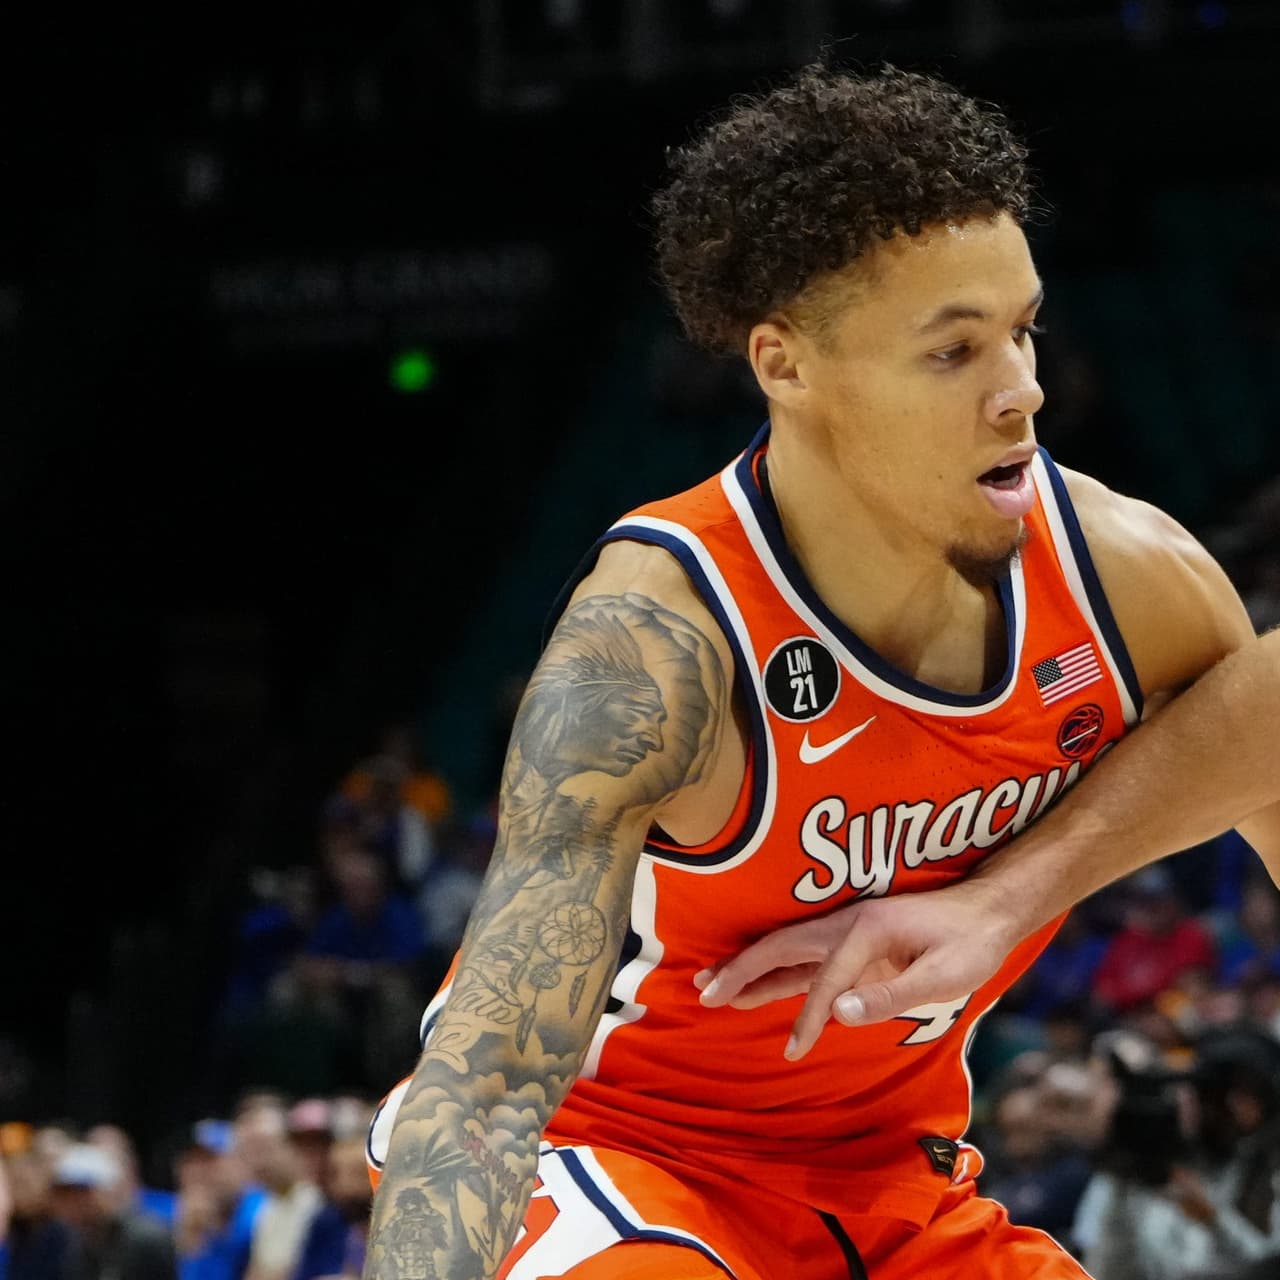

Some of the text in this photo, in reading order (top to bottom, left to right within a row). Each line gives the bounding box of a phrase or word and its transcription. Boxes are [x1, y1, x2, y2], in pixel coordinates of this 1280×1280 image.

[786, 646, 812, 676] LM
[790, 674, 818, 713] 21
[794, 745, 1112, 903] Syracu
